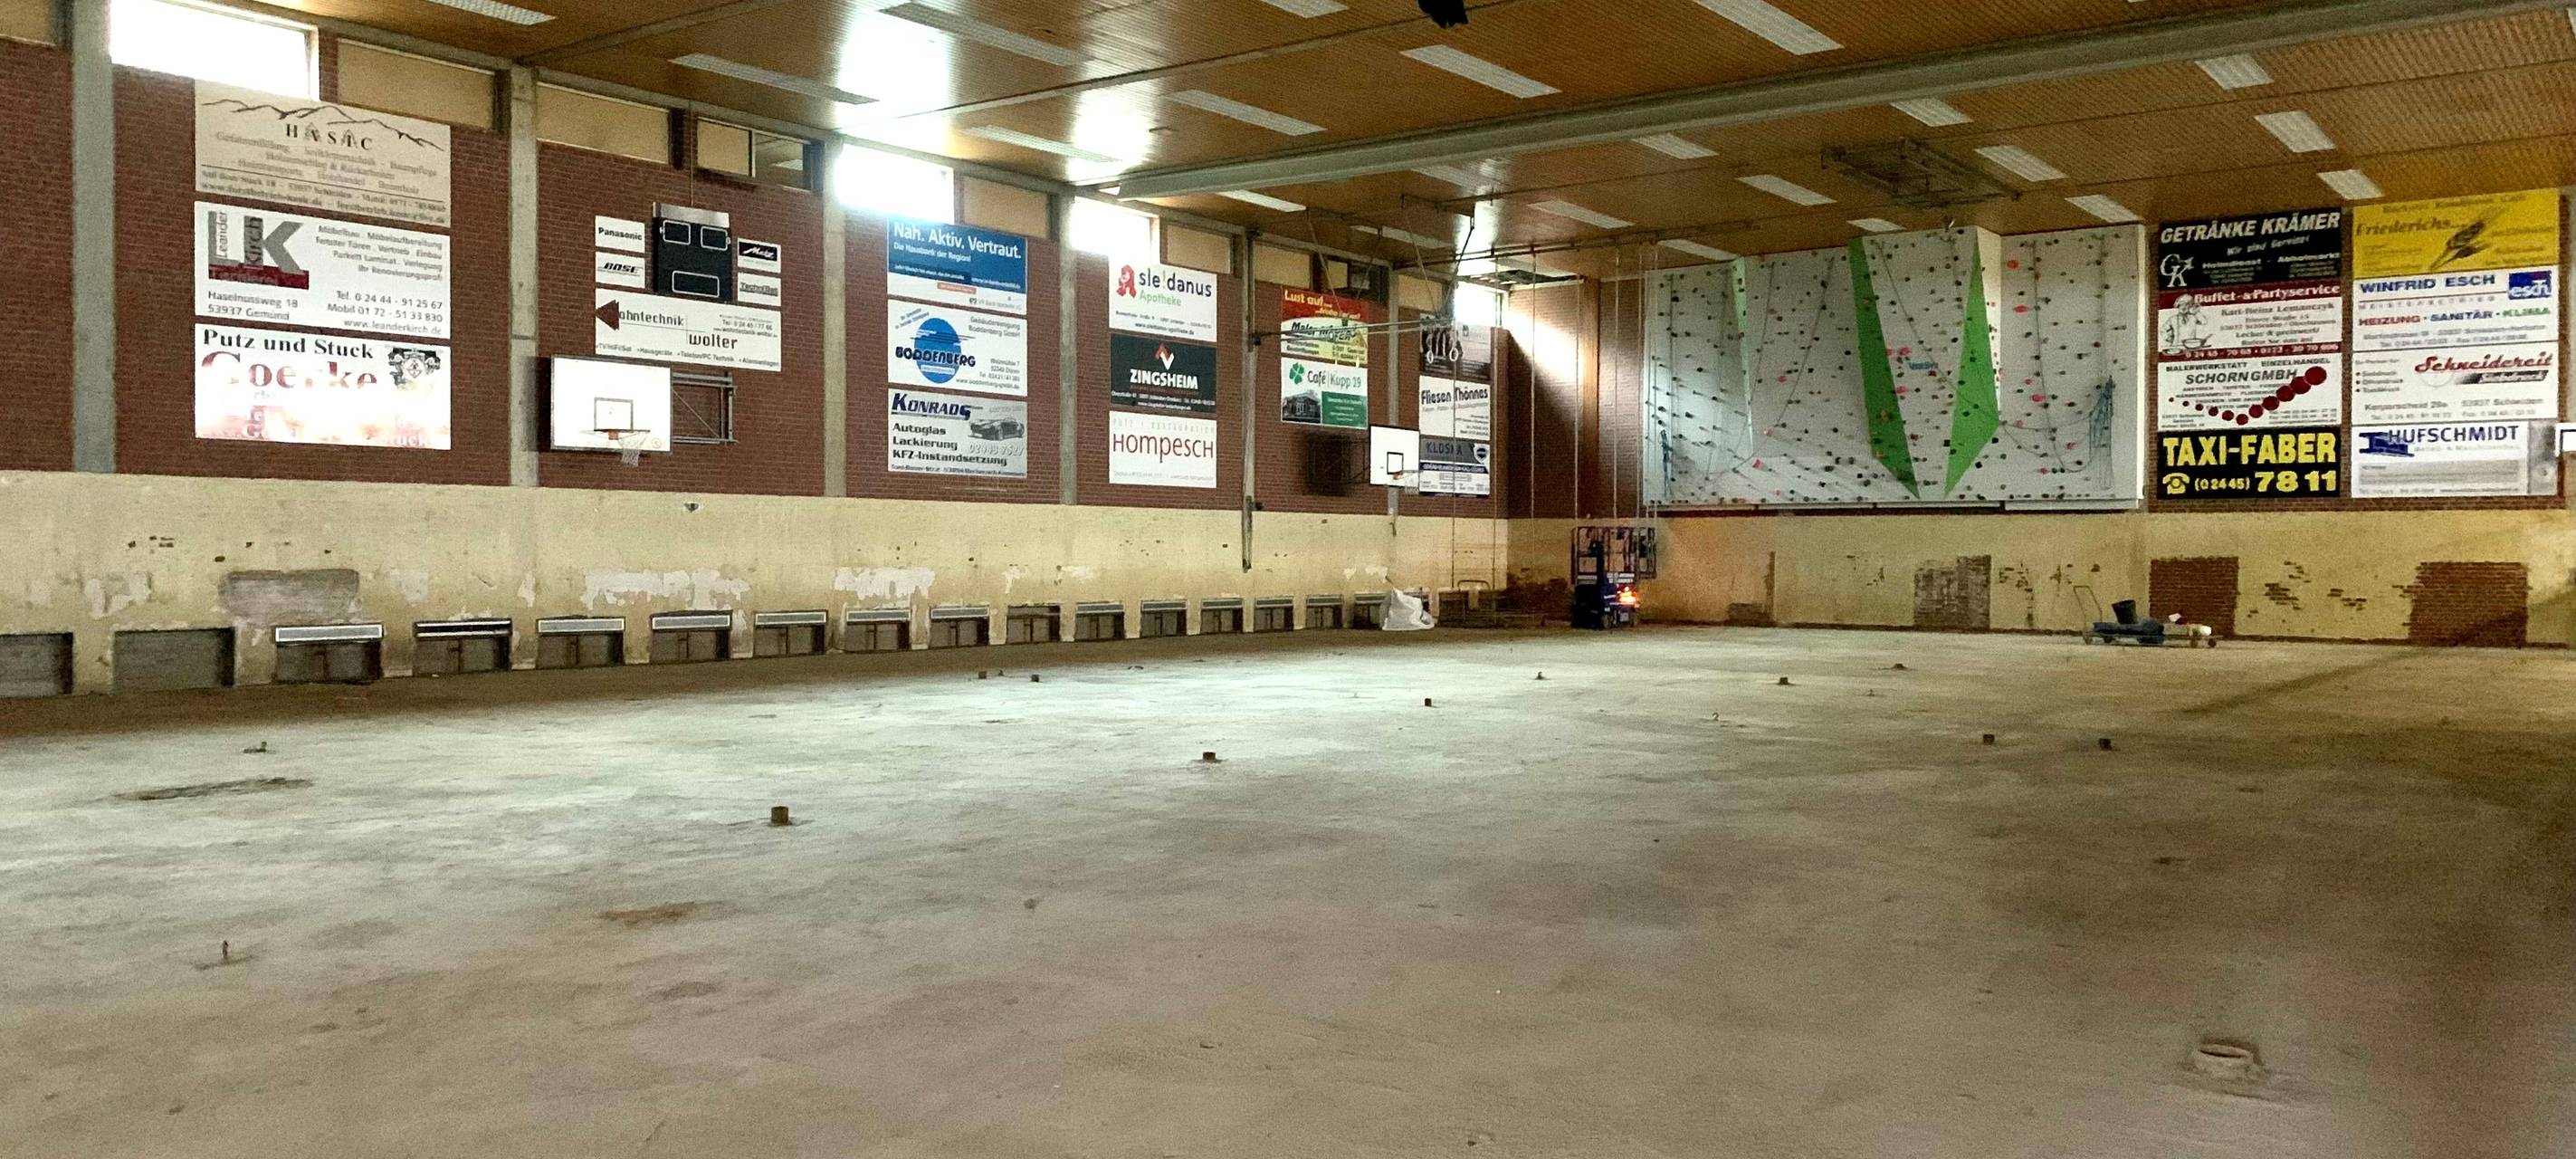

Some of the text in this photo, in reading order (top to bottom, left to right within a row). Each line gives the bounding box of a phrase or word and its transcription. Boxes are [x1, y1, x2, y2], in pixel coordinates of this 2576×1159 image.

[597, 226, 643, 241] Panasonic
[2160, 211, 2342, 244] GETRÄNKE KRÄMER
[893, 221, 1022, 260] Nah. Aktiv. Vertraut.
[2253, 283, 2341, 300] Partyservice
[2359, 273, 2496, 294] WINFRID ESCH
[364, 294, 377, 303] 24
[379, 295, 392, 304] 44
[401, 297, 413, 307] 91
[416, 299, 428, 309] 25
[430, 301, 443, 310] 67
[1138, 289, 1182, 307] Apotheke
[1283, 289, 1306, 304] Lust
[207, 303, 243, 316] 53937
[327, 303, 356, 314] Mobil
[374, 307, 386, 318] 72
[395, 310, 407, 319] 51
[425, 313, 444, 323] 830
[2358, 306, 2551, 327] HEIZUNG SANITÄR KLIMA
[203, 329, 375, 359] Putz und Stuck
[689, 333, 739, 350] wolter
[894, 346, 977, 368] BODDENBERG
[2165, 357, 2332, 372] MALERWERKSTATT EINZELHANDEL
[2414, 350, 2553, 373] Schneidereit
[1129, 368, 1199, 390] ZINGSHEIM
[1307, 369, 1327, 387] Café
[1330, 372, 1352, 389] Kupp
[2185, 368, 2298, 385] SCHORN GMBH
[892, 392, 972, 418] KONRADS
[1420, 388, 1453, 406] Fliesen
[892, 422, 947, 436] Autoglas
[2388, 425, 2520, 444] HUFSCHMIDT
[892, 436, 959, 452] Lackierung
[2161, 431, 2337, 467] TAXI-FABER
[892, 449, 1008, 467] KFZ-Instandsetzung
